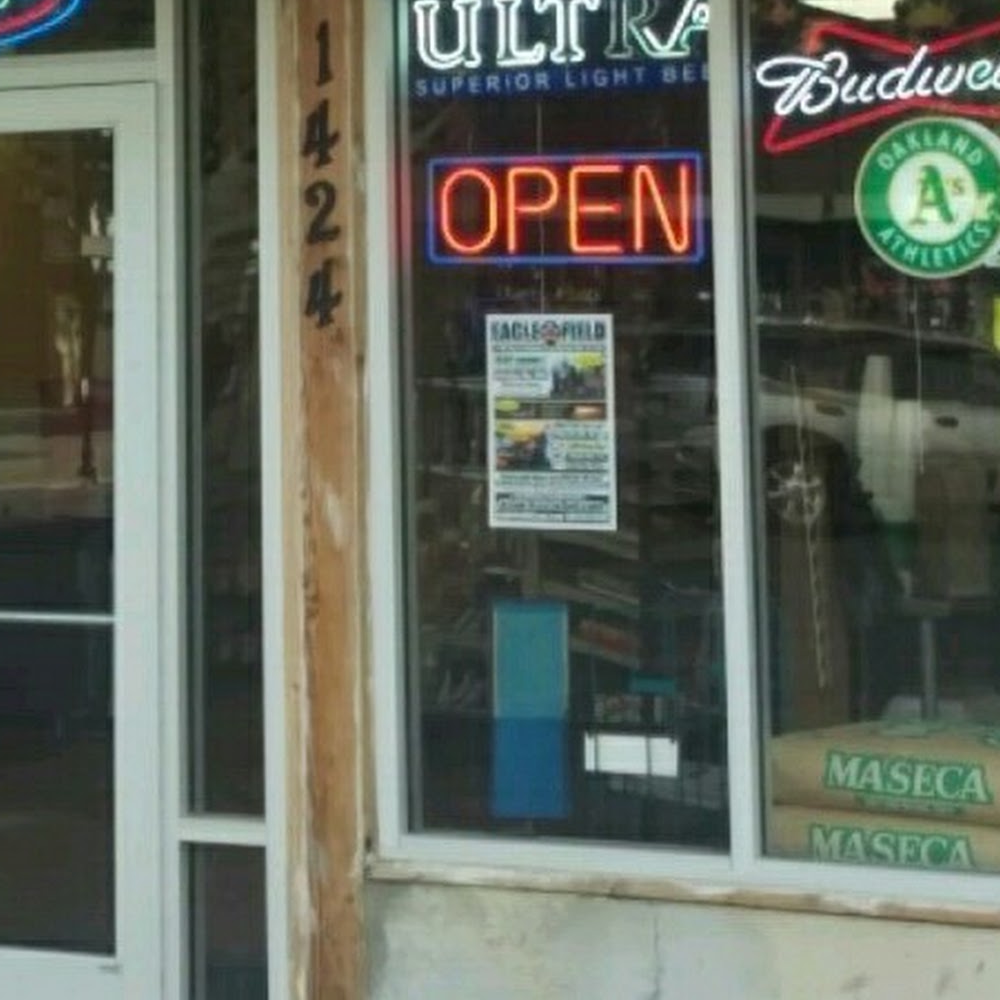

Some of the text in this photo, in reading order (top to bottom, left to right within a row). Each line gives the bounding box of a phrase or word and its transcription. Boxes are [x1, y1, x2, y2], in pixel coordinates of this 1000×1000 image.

[415, 72, 551, 97] SUPERIOR
[564, 67, 645, 88] LIGHT
[876, 128, 984, 171] OAKLAND
[440, 163, 690, 255] OPEN
[877, 222, 992, 268] ATHLETICS
[826, 752, 990, 803] MASECA
[810, 826, 975, 868] MASECA
